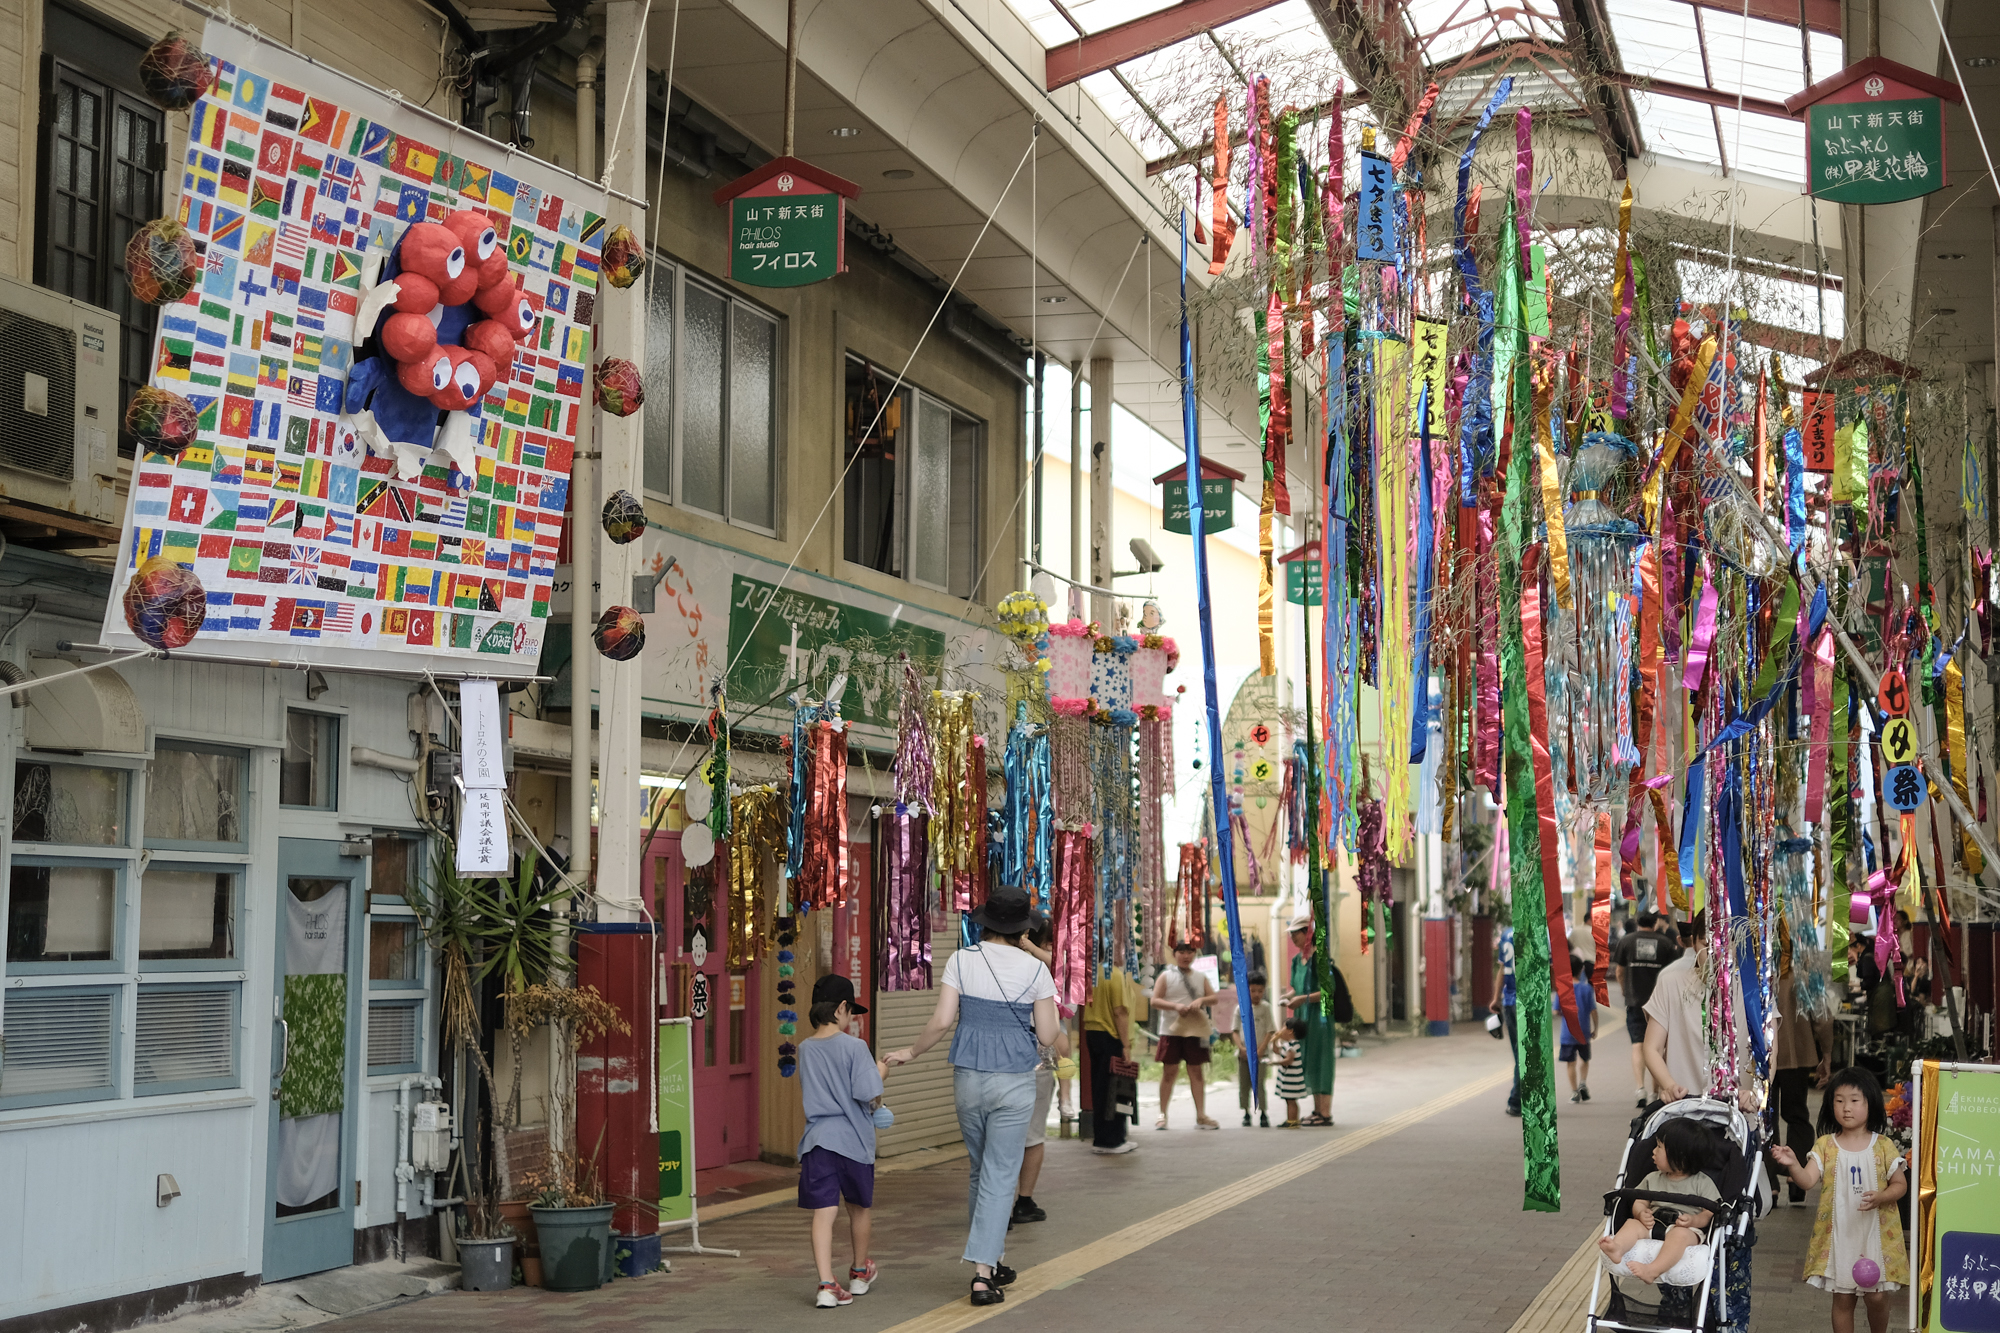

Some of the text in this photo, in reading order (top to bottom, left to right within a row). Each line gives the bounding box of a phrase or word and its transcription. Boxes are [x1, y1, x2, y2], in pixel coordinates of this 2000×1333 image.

[1828, 110, 1924, 131] 山下新天街
[746, 204, 824, 221] 山下新天街
[1367, 164, 1386, 253] 七夕まつり
[741, 226, 782, 240] PHILOS
[740, 241, 780, 250] hair studio
[751, 251, 818, 271] フィロス
[83, 322, 104, 336] National
[1173, 484, 1224, 496] 山天街
[1169, 509, 1227, 519] カクツヤ
[486, 633, 512, 649] くりみ荘
[524, 638, 539, 647] EXPO
[523, 647, 538, 655] 2025
[476, 710, 491, 778] トトロみのる園
[478, 793, 493, 864] 延岡市議会議長賞
[691, 978, 709, 1014] 祭
[1960, 1095, 2000, 1105] EKIMAC
[1960, 1105, 2000, 1114] NOBEO
[1939, 1145, 2000, 1161] YAMA
[1937, 1161, 2000, 1177] SHINT
